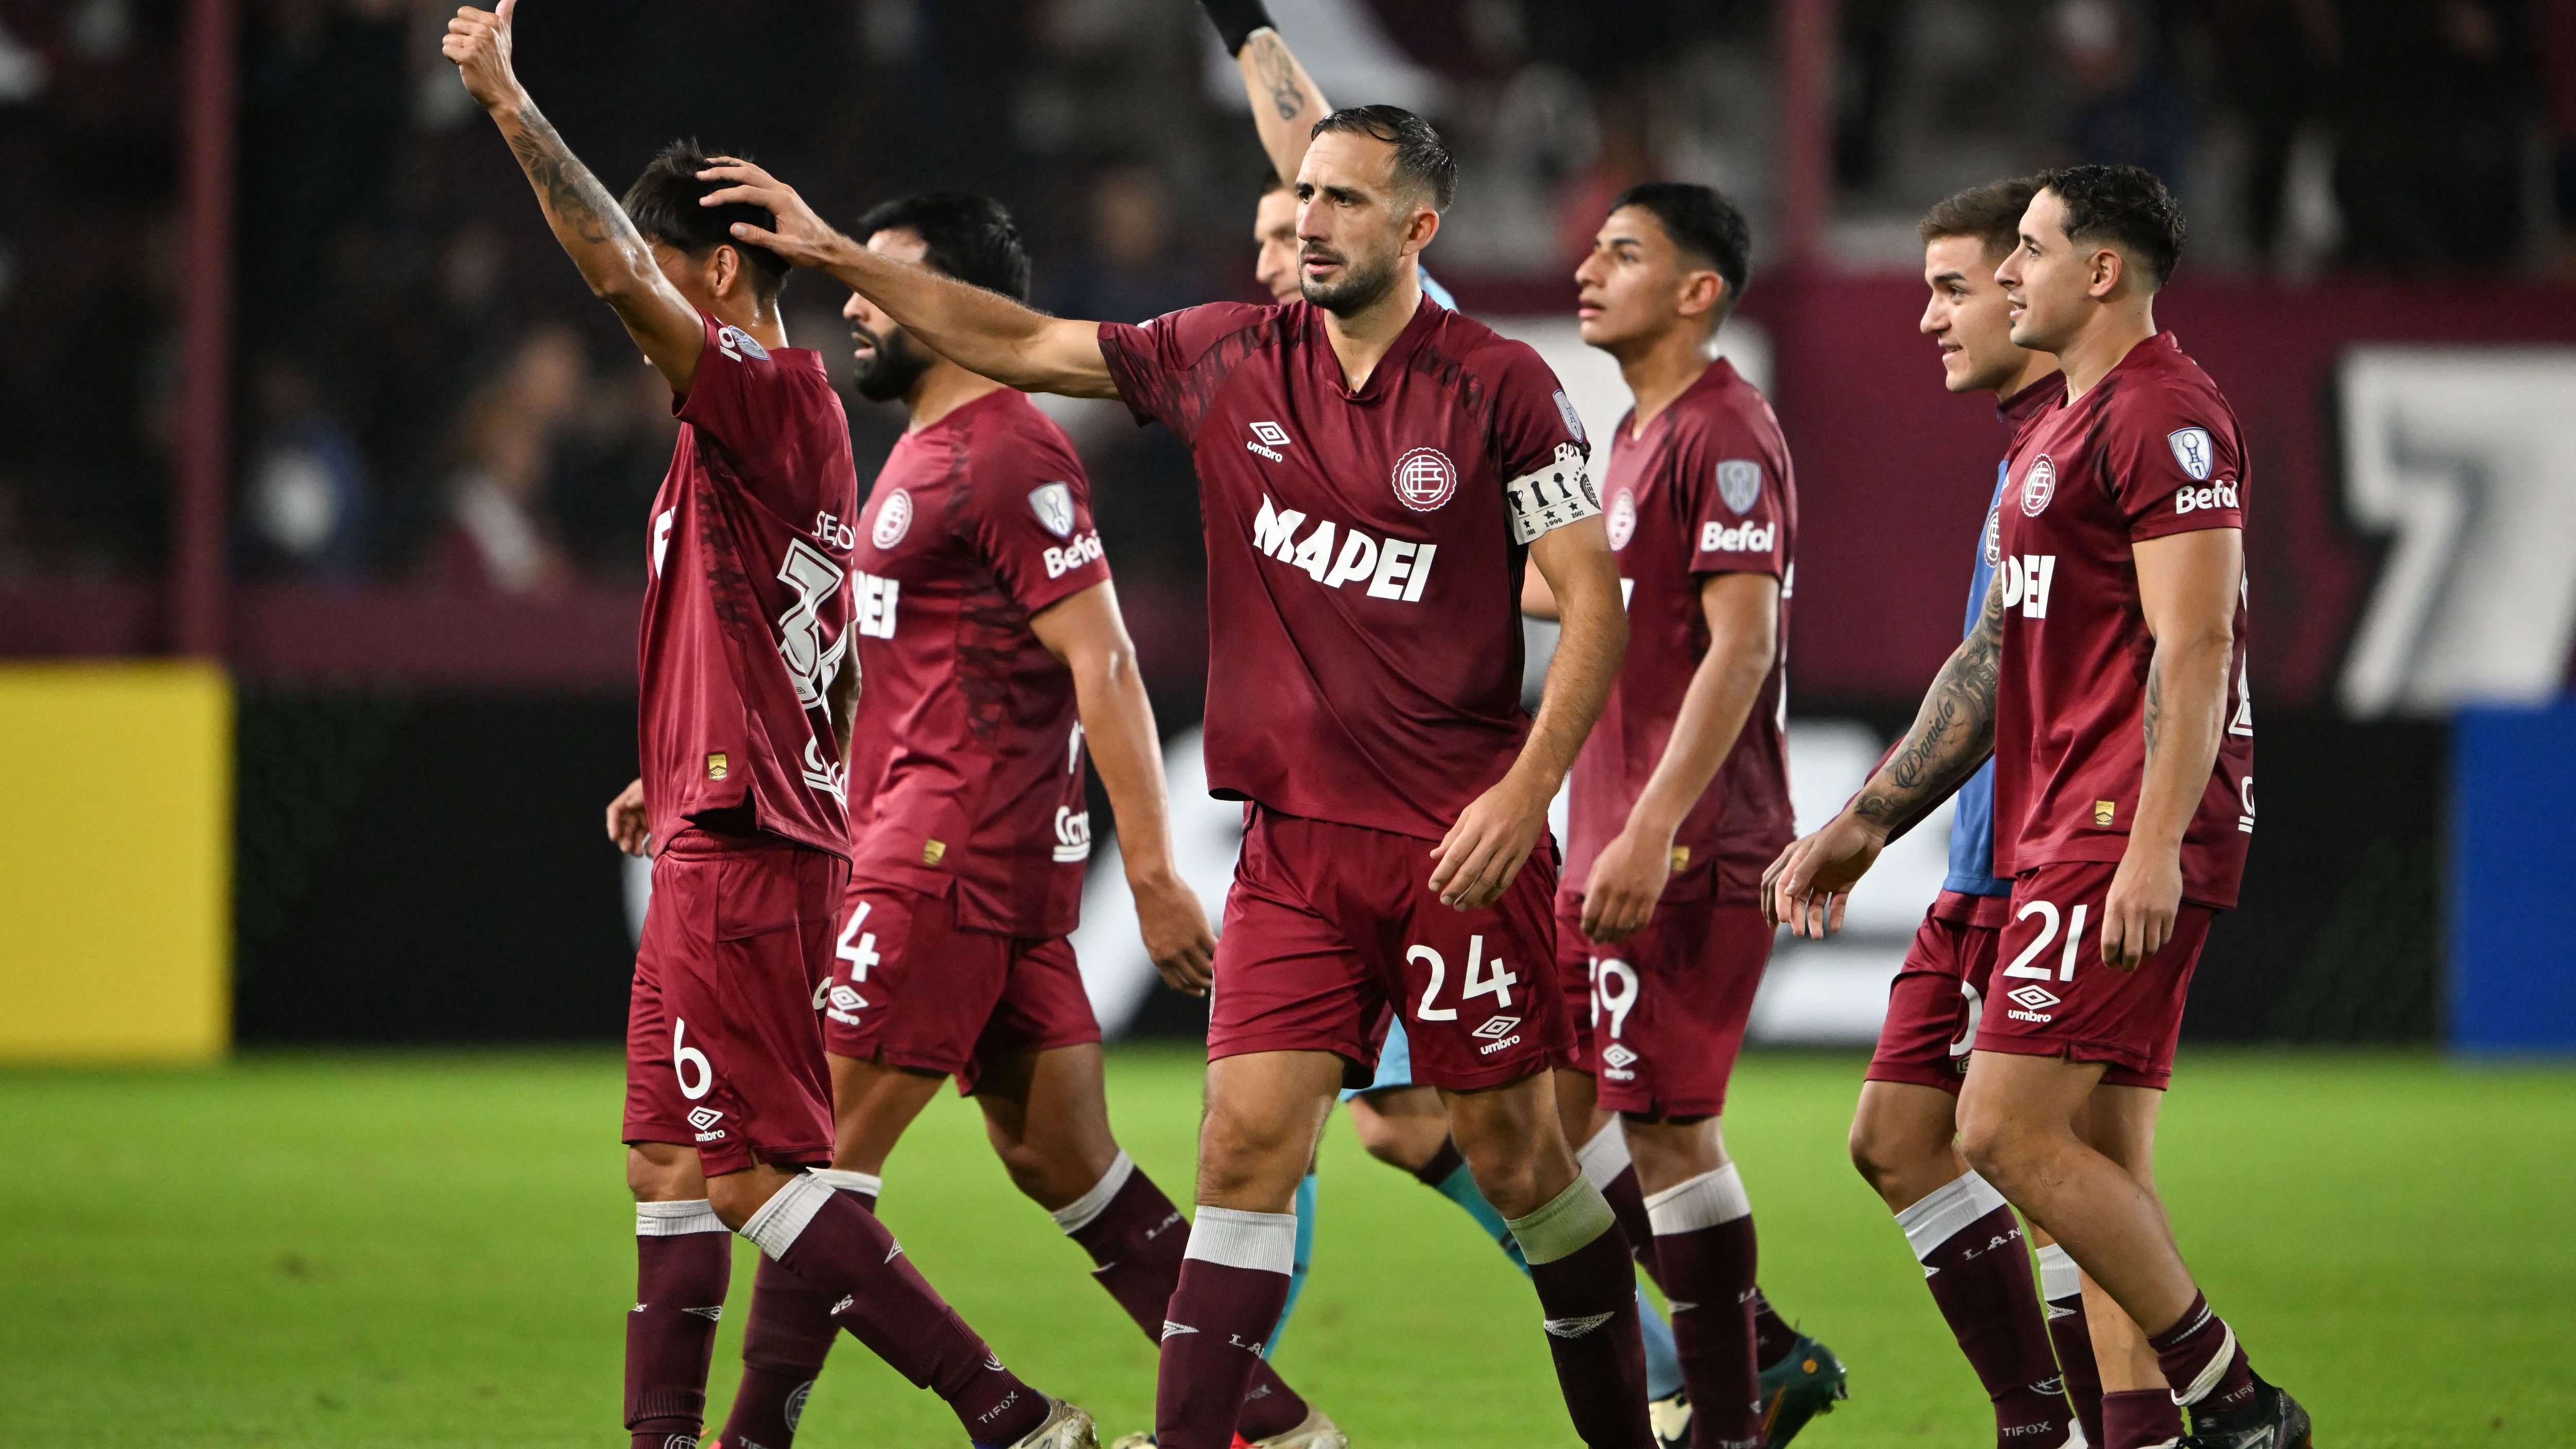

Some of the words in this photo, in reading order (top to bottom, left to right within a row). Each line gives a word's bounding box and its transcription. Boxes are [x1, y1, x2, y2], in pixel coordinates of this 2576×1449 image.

[1247, 441, 1283, 463] umbro
[2176, 479, 2239, 514] Befol
[1572, 510, 1585, 518] 2007
[1253, 493, 1437, 602] MAPEI
[1700, 520, 1776, 552] Befol
[1894, 681, 1956, 789] Daniela
[836, 900, 881, 983] 4
[2003, 900, 2087, 982] 21
[1406, 935, 1517, 1021] 24
[2008, 1009, 2052, 1022] umbro
[673, 1016, 712, 1099] 6
[1481, 1034, 1520, 1055] umbro
[695, 1129, 725, 1142] umbro
[978, 1390, 1019, 1424] TIFOX
[2222, 1382, 2254, 1402] TIFO
[2003, 1421, 2052, 1437] TIFOX
